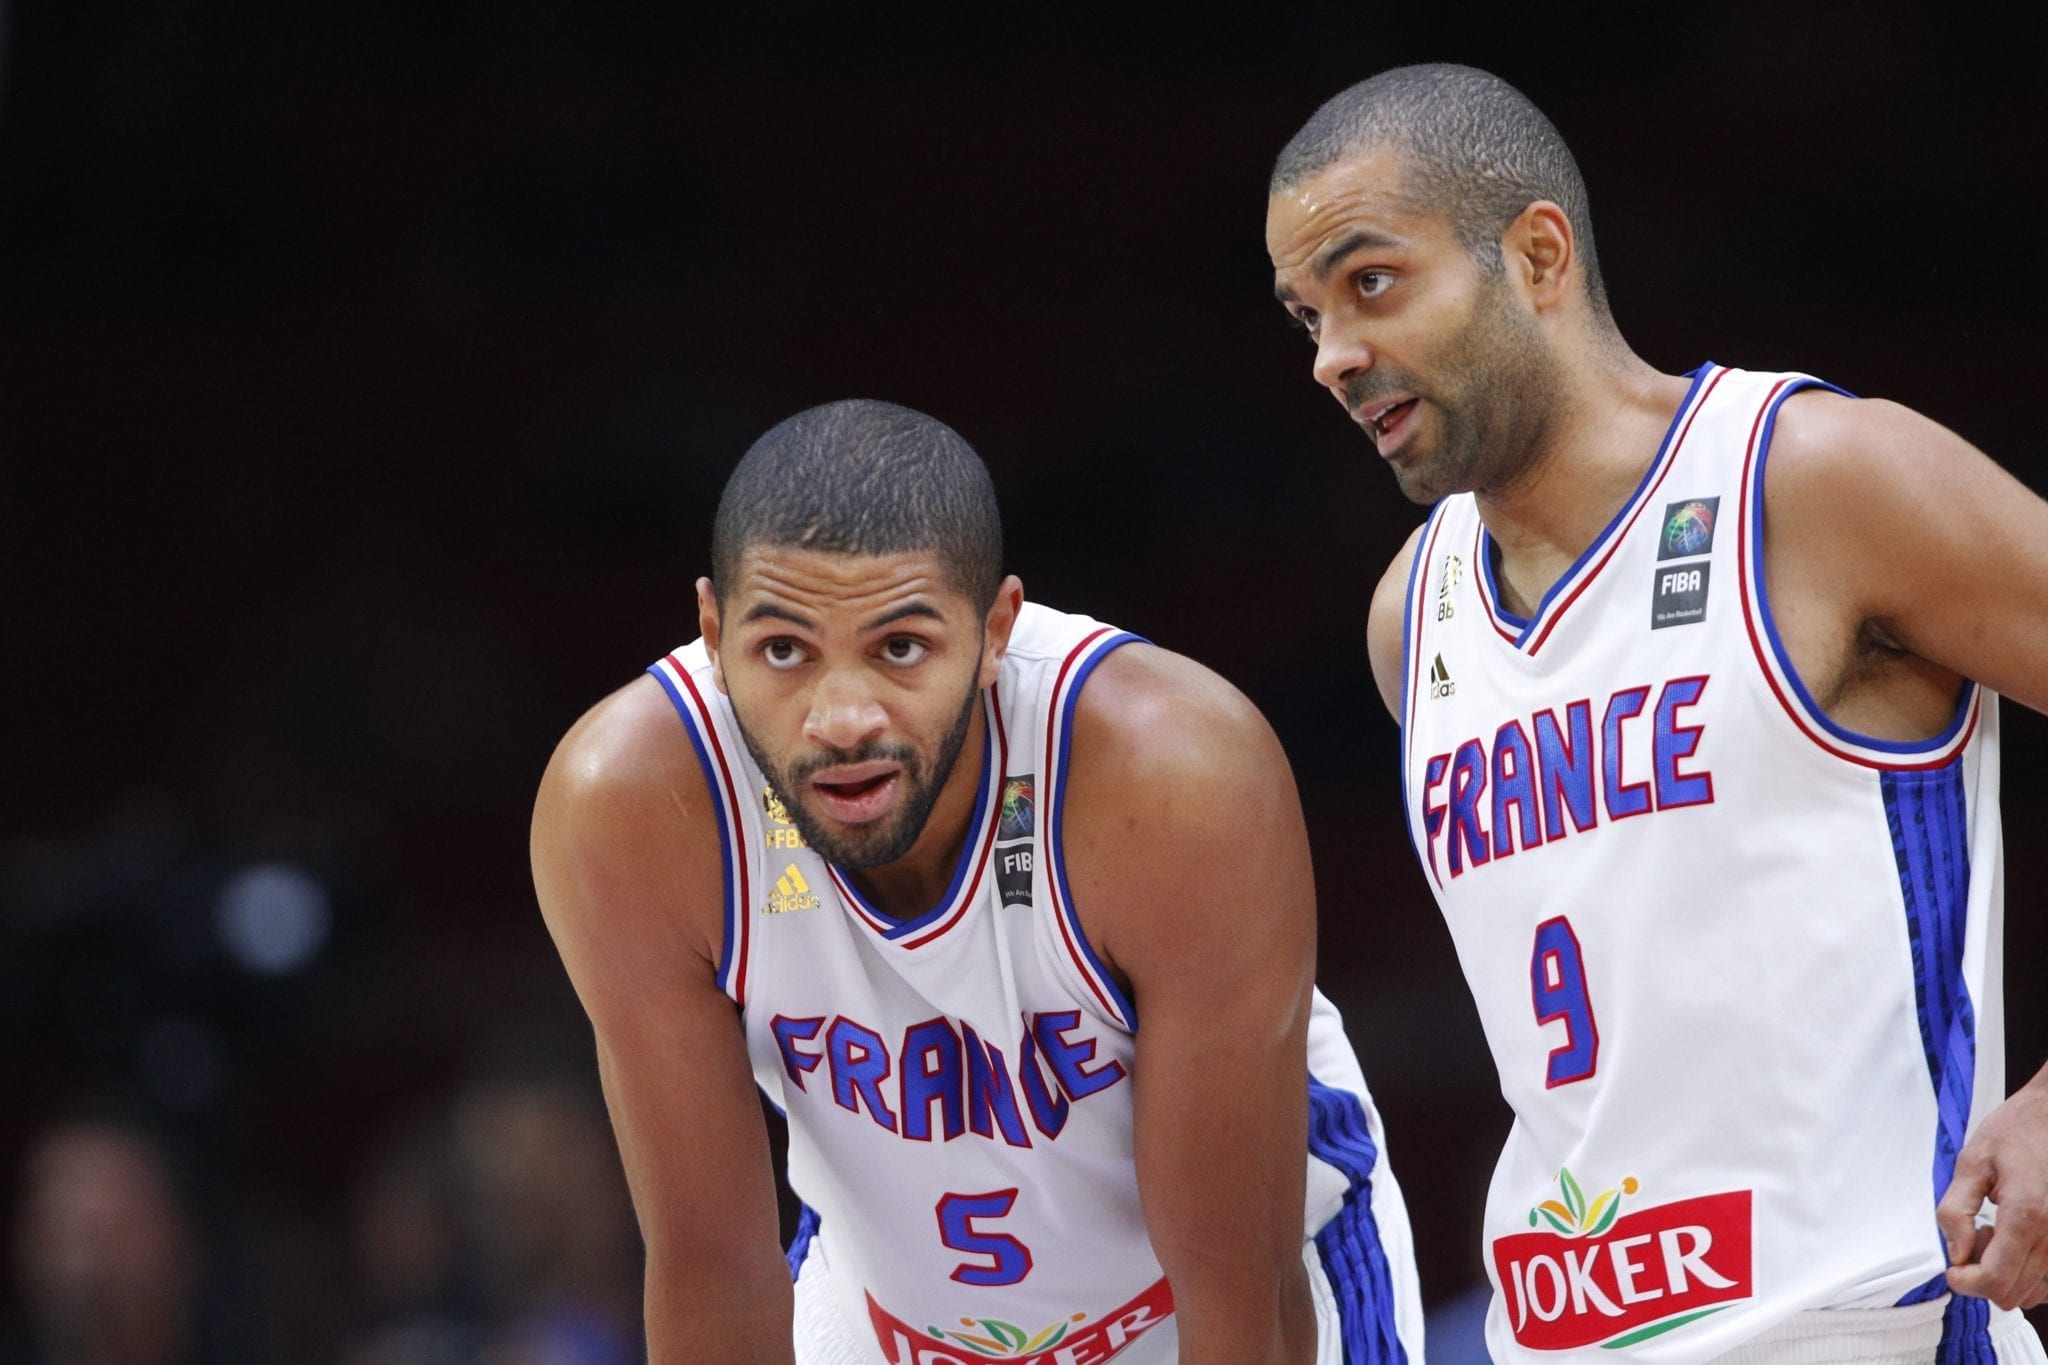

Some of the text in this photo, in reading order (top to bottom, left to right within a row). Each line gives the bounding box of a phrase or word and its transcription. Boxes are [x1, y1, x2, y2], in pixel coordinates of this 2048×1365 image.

[1661, 569, 1701, 596] FIBA
[1422, 674, 1715, 892] FRANCE
[766, 828, 807, 849] FFB
[1004, 851, 1032, 874] FIB
[1530, 914, 1600, 1090] 9
[769, 1009, 1128, 1150] FRANCE
[935, 1187, 1034, 1287] 5
[1510, 1224, 1740, 1334] JOKER
